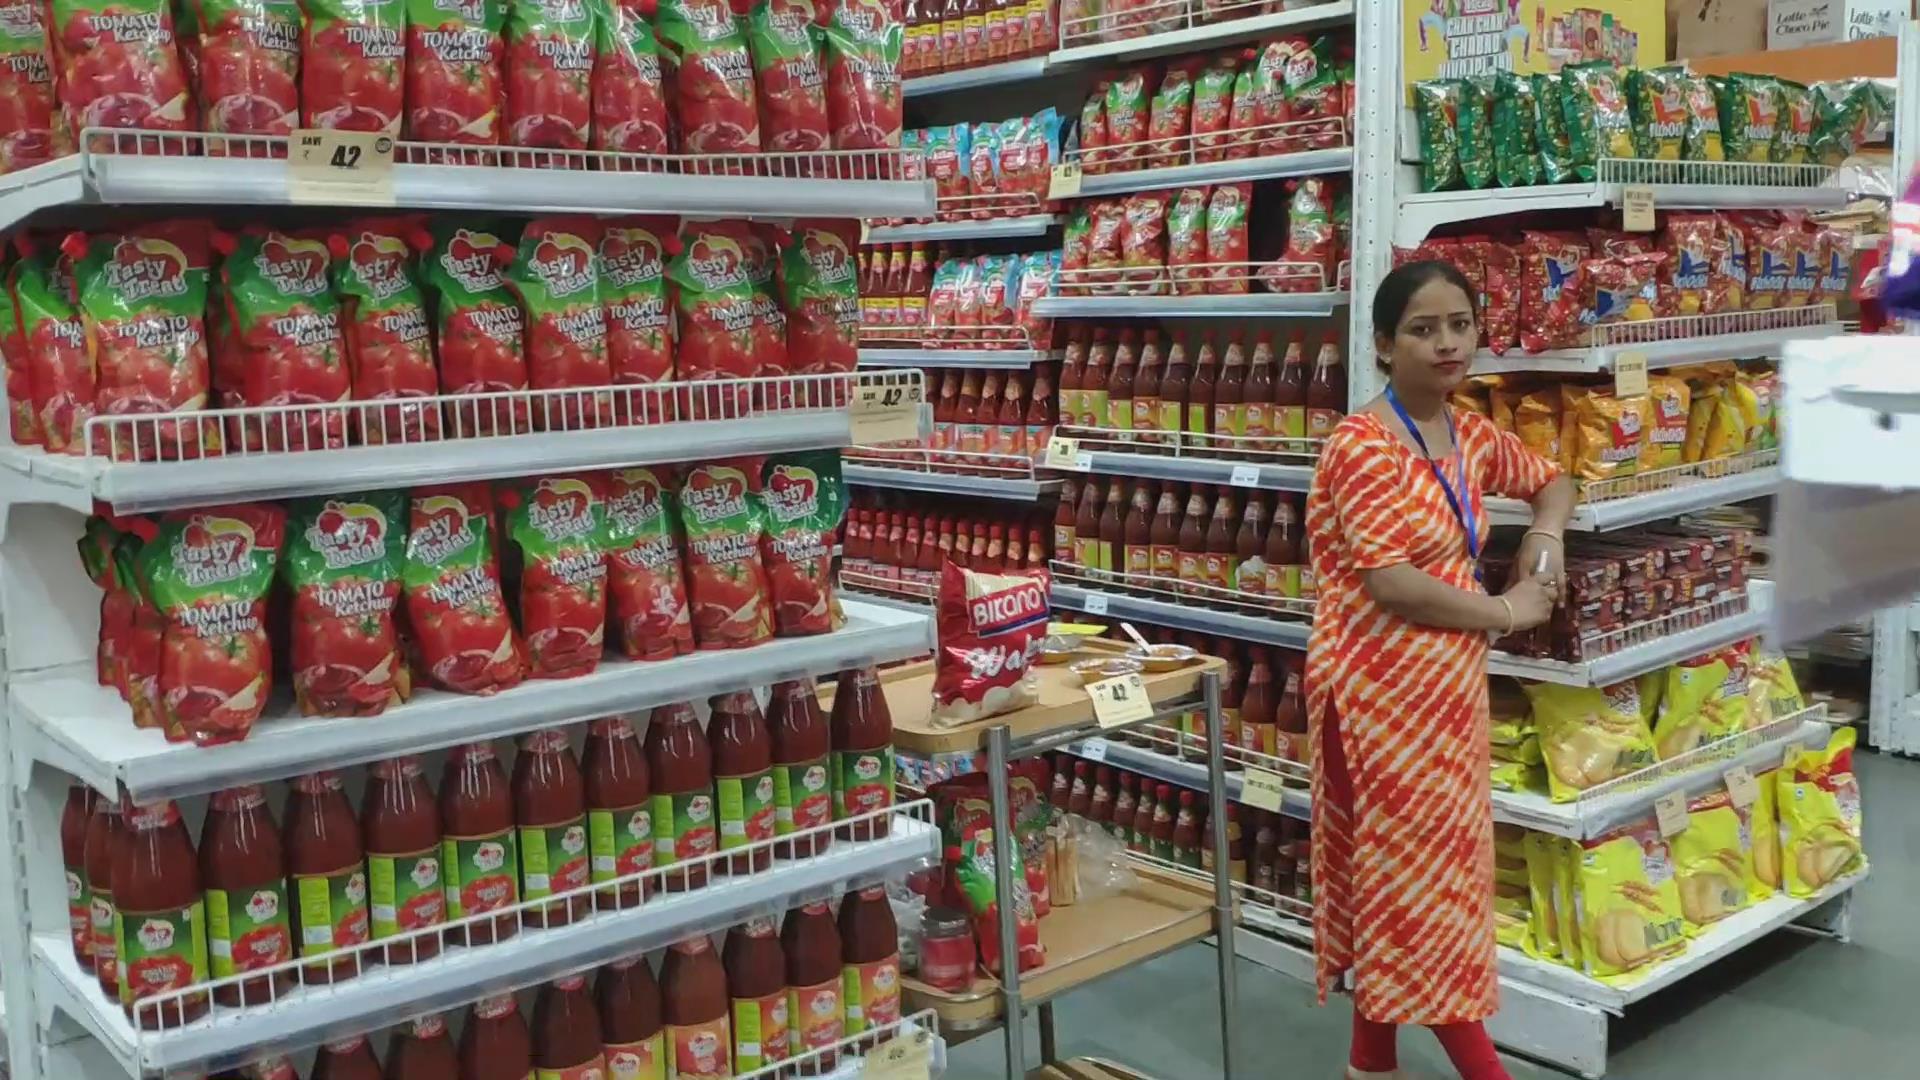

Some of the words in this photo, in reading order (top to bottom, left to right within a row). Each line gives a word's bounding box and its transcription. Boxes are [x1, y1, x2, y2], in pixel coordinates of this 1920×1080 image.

[89, 13, 160, 32] TOMATO
[1777, 12, 1806, 24] Lotte
[1850, 8, 1873, 24] Lotte
[115, 28, 171, 43] Ketchup
[345, 27, 397, 44] TOMATO
[1775, 24, 1810, 36] Choco
[1812, 20, 1830, 32] Pie
[423, 31, 488, 49] TOMATO
[539, 40, 591, 58] TOMATO
[438, 46, 493, 63] Ketchup
[331, 145, 361, 167] 42
[260, 258, 312, 280] Tasty
[445, 252, 493, 278] Tasty
[534, 253, 577, 278] Tasty
[600, 247, 647, 274] Tasty
[689, 256, 730, 276] Tasty
[109, 257, 167, 288] Tasty
[549, 266, 595, 295] Treat
[613, 259, 661, 287] Treat
[704, 268, 747, 290] Treat
[124, 275, 187, 301] Treat
[466, 305, 521, 326] TOMATO
[555, 306, 603, 332] TOMATO
[610, 299, 664, 319] TOMATO
[816, 299, 857, 318] TOMATO
[118, 315, 189, 339] TOMATO
[271, 312, 337, 335] TOMATO
[136, 327, 200, 348] Ketchup
[880, 387, 902, 406] 42
[608, 487, 646, 515] Tasty
[684, 482, 733, 505] Tasty
[766, 484, 806, 504] Tasty
[530, 497, 576, 526] Tasty
[698, 499, 746, 521] Treat
[776, 498, 818, 519] Treat
[310, 518, 368, 548] Tasty
[544, 514, 594, 540] Treat
[421, 528, 476, 564] Treat
[624, 535, 673, 566] TOMATO
[694, 533, 746, 555] TOMATO
[774, 531, 822, 553] TOMATO
[178, 540, 236, 567] Tasty
[324, 540, 383, 568] Treat
[549, 550, 601, 577] TOMATO
[708, 546, 758, 564] Ketchup
[188, 556, 252, 584] Treat
[316, 581, 386, 608] TOMATO
[427, 566, 486, 604] TOMATO
[446, 578, 497, 609] Ketchup
[181, 601, 251, 626] TOMATO
[335, 596, 394, 618] Ketchup
[196, 615, 259, 638] Ketchup
[1112, 683, 1129, 701] 42
